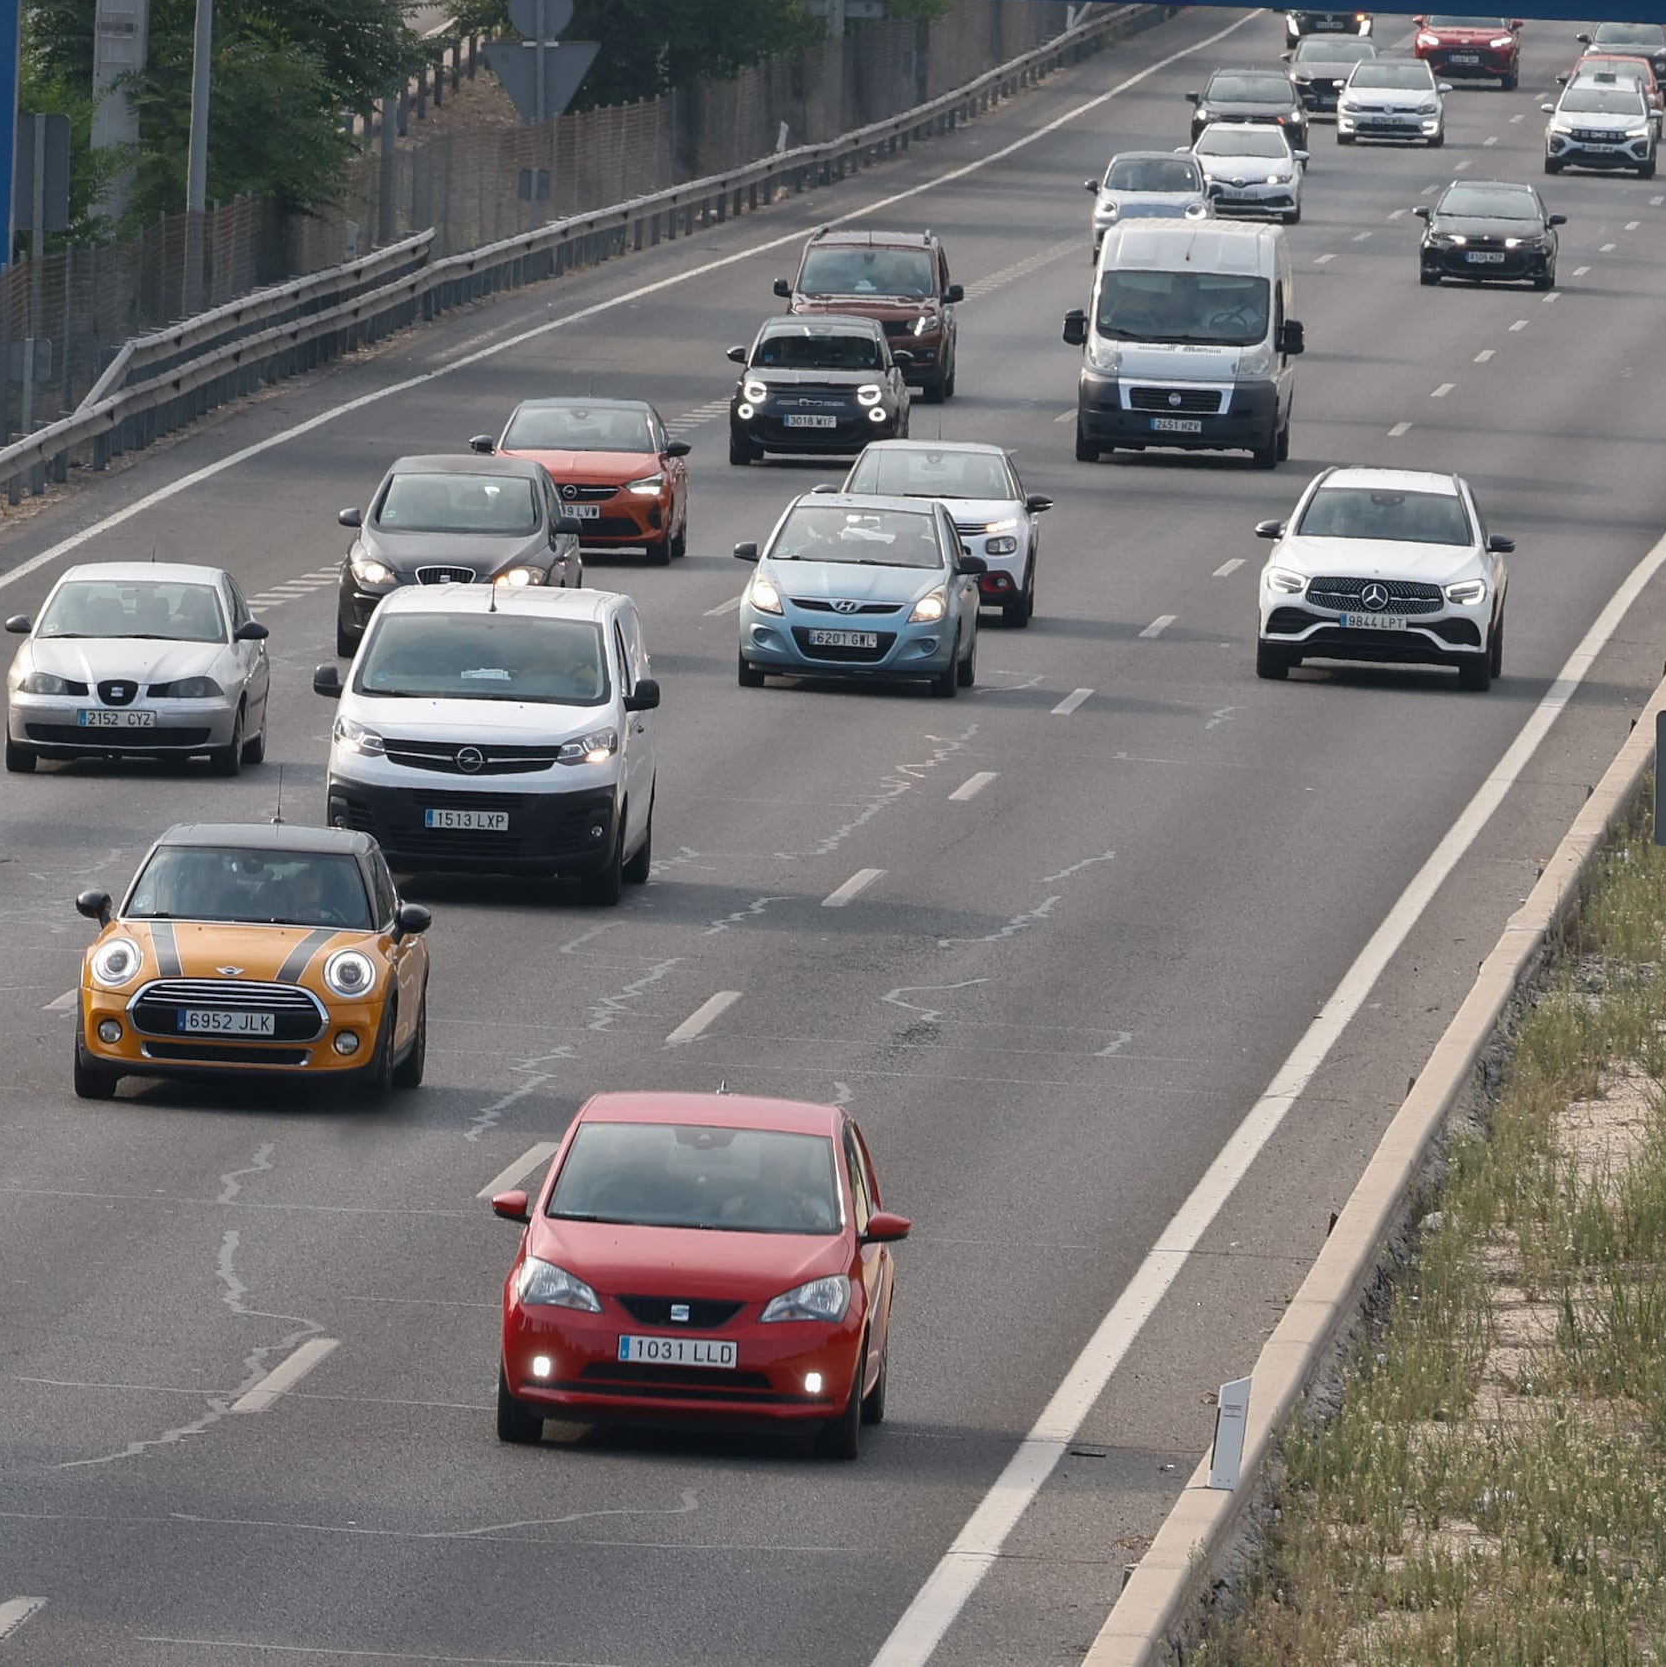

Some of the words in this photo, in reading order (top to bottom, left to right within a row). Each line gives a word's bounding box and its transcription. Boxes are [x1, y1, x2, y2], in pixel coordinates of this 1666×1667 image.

[1348, 614, 1377, 628] 9844
[1381, 615, 1404, 629] LPT
[816, 631, 846, 645] 6201
[88, 712, 119, 726] 2152
[127, 713, 151, 726] CYZ
[437, 811, 473, 827] 1513
[477, 813, 504, 829] LXP
[189, 1013, 233, 1030] 6952
[239, 1015, 271, 1031] JLK
[636, 1338, 683, 1361] 1031
[693, 1342, 732, 1364] LLD
